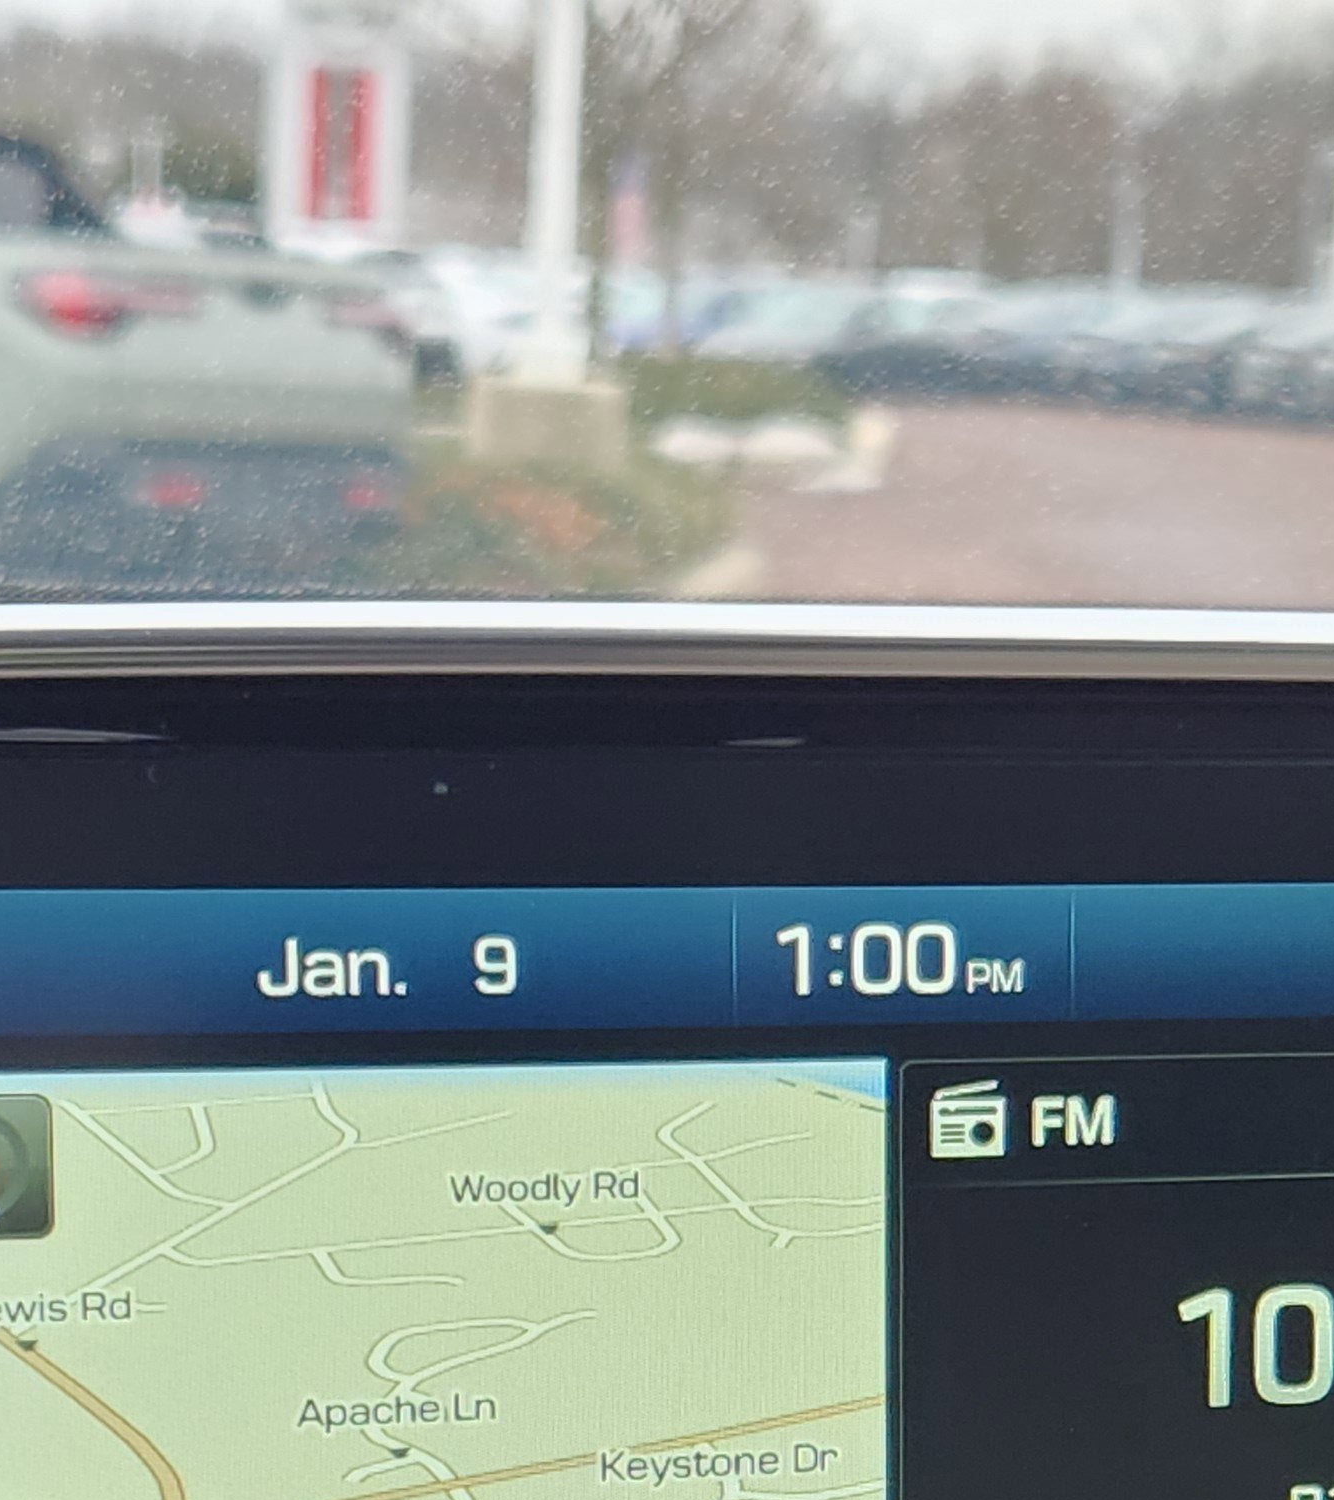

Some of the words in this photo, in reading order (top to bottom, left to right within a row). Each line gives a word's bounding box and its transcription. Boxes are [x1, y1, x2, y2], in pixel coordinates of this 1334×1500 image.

[256, 937, 408, 998] Jan.
[473, 935, 518, 995] 9
[1030, 1093, 1116, 1148] FM
[450, 1172, 581, 1208] Woodly
[593, 1170, 640, 1200] Rd
[80, 1290, 132, 1321] Rd
[296, 1395, 441, 1434] Apache
[452, 1392, 497, 1422] Ln
[599, 1449, 780, 1488] Keystone
[793, 1442, 839, 1474] Dr
